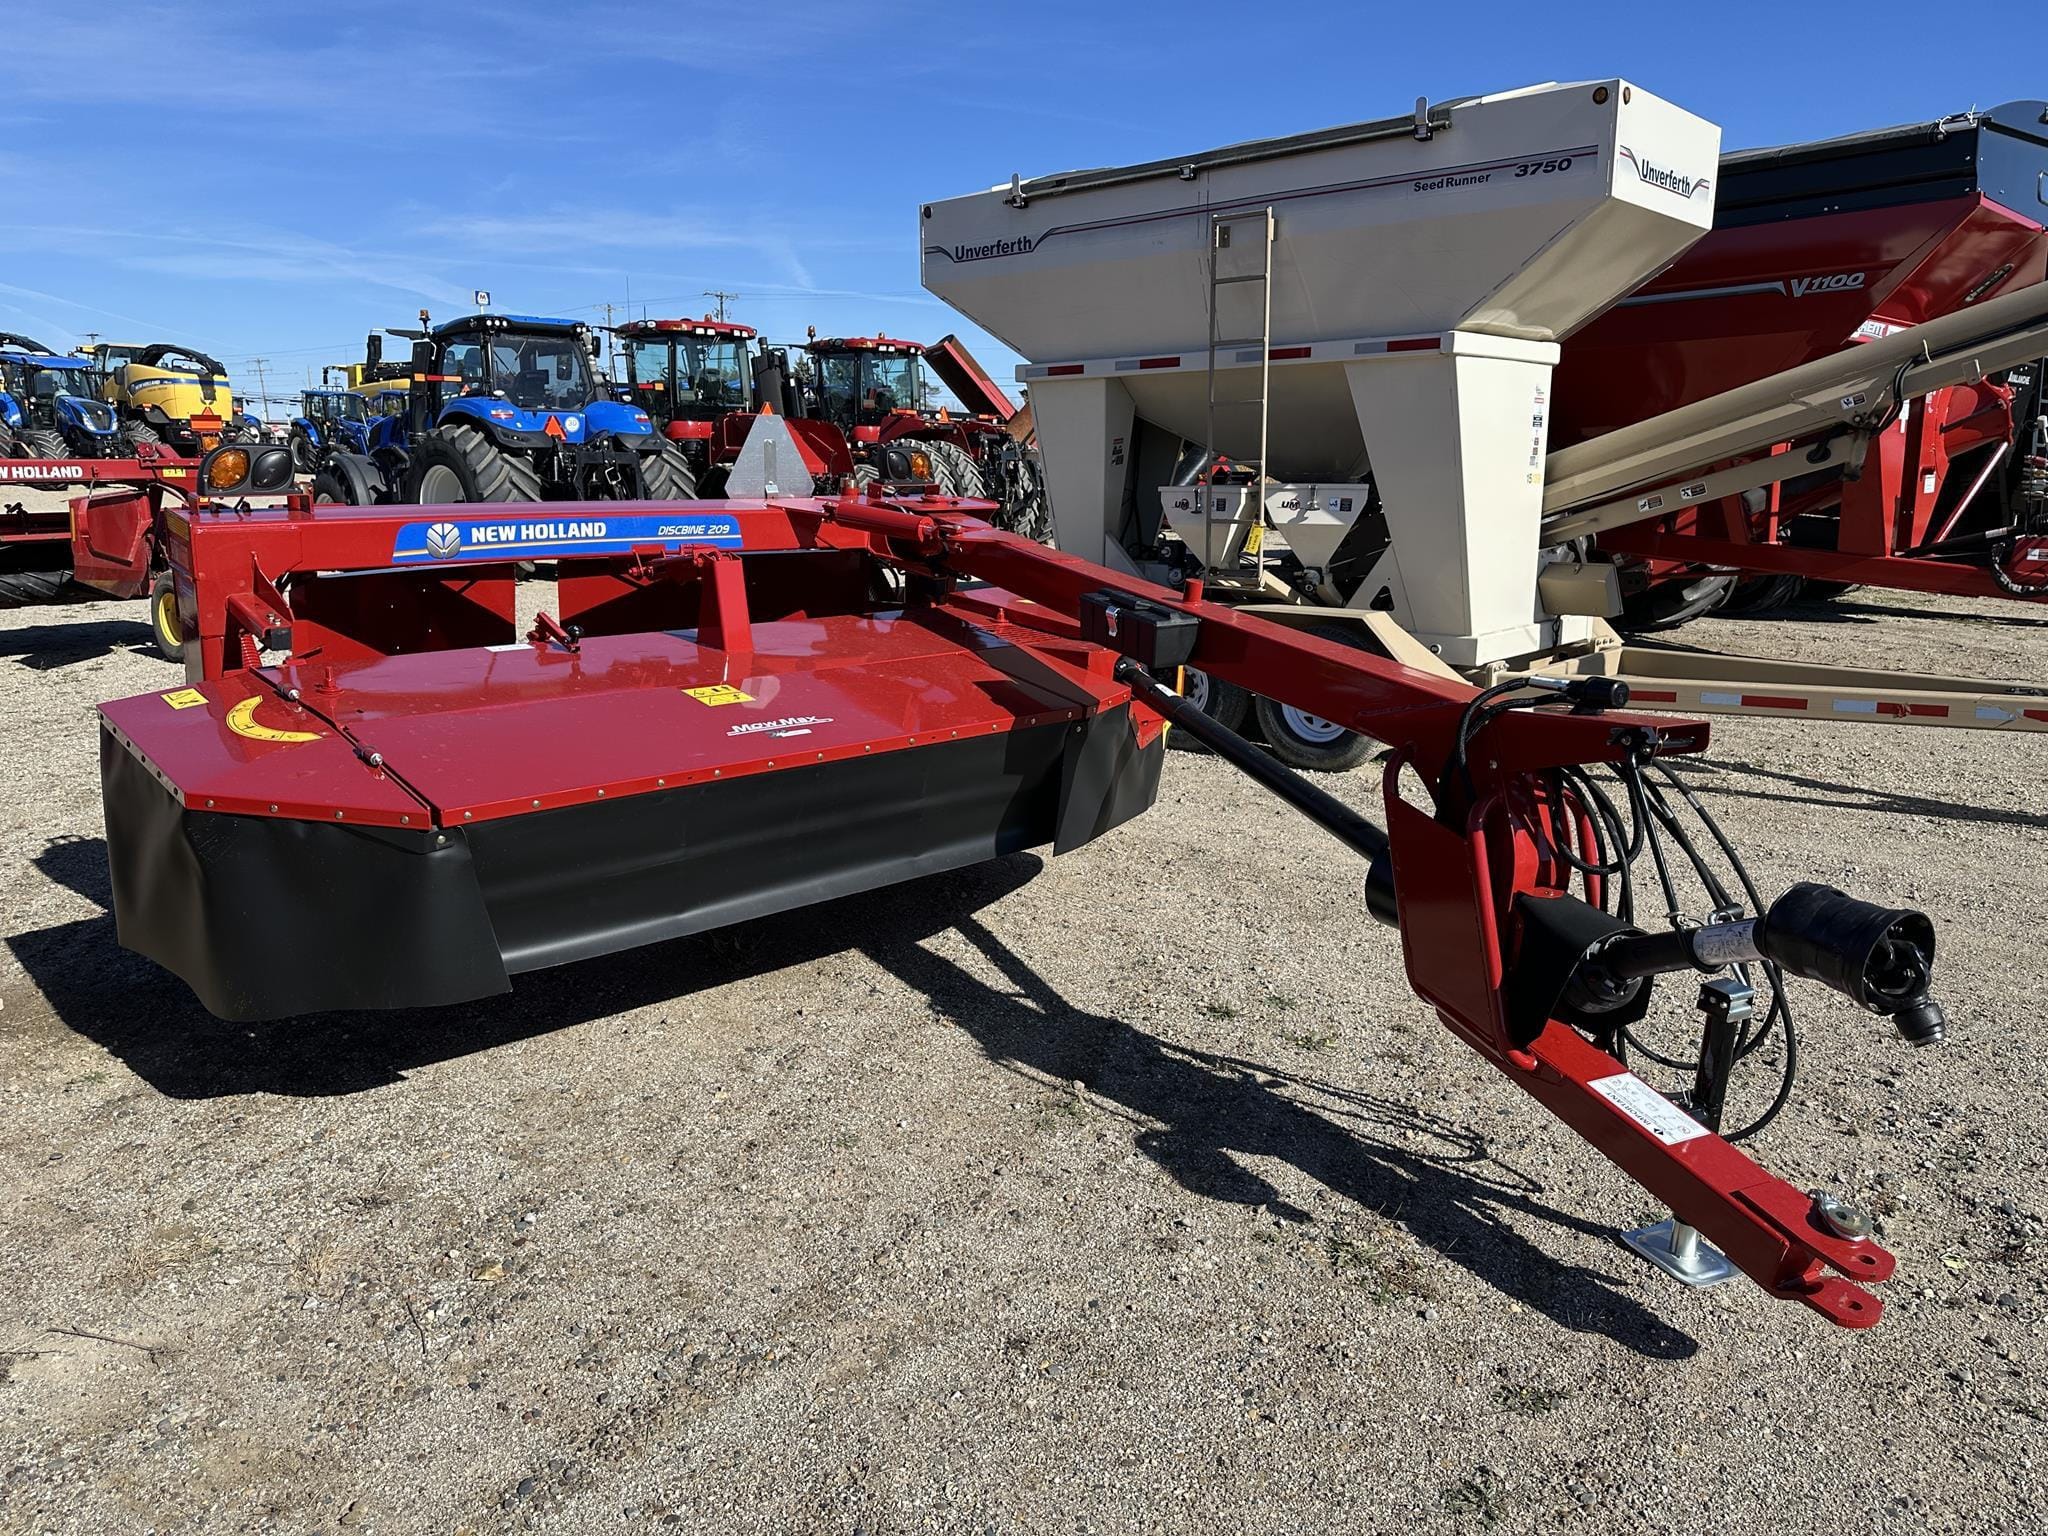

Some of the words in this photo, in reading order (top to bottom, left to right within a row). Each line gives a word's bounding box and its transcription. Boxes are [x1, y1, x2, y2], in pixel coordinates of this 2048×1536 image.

[1413, 178, 1444, 193] Seed
[1445, 173, 1492, 189] Runner
[1514, 157, 1573, 178] 3750
[1641, 158, 1690, 195] Unverferth
[954, 235, 1033, 261] Unverferth
[1790, 272, 1866, 298] V1100
[11, 465, 84, 479] HOLLAND
[470, 525, 517, 544] NEW
[520, 521, 607, 541] HOLLAND
[657, 524, 705, 536] DISCBINE
[707, 523, 731, 535] 209
